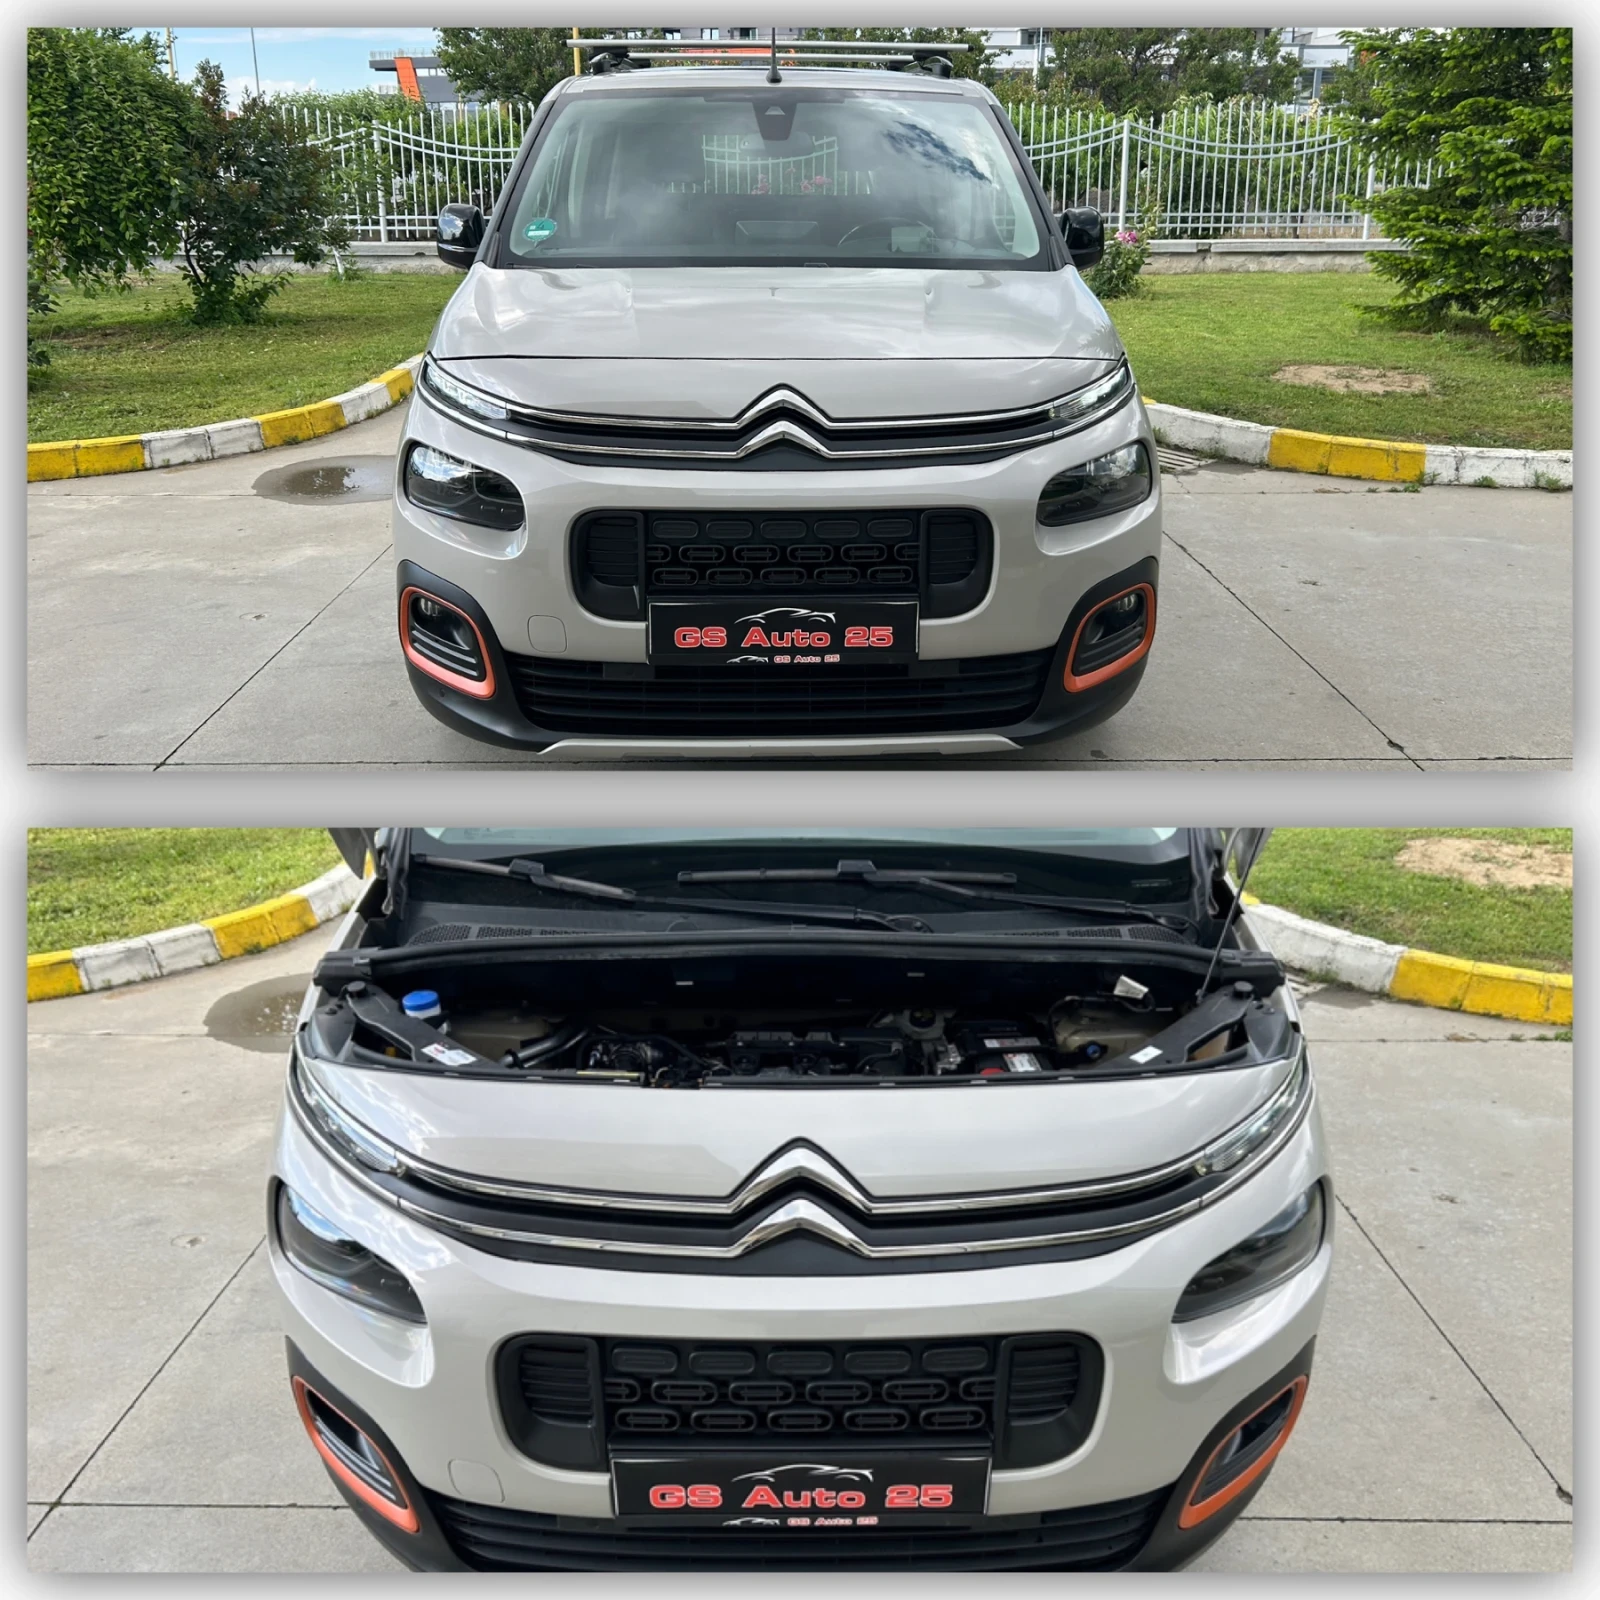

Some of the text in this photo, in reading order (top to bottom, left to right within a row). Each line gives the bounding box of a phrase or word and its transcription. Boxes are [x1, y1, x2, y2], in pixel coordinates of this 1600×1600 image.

[674, 626, 894, 648] GS Auto 25
[774, 654, 840, 664] GS Auto 25
[649, 1485, 953, 1508] GS Auto 25
[787, 1515, 878, 1526] GS Auto 25
